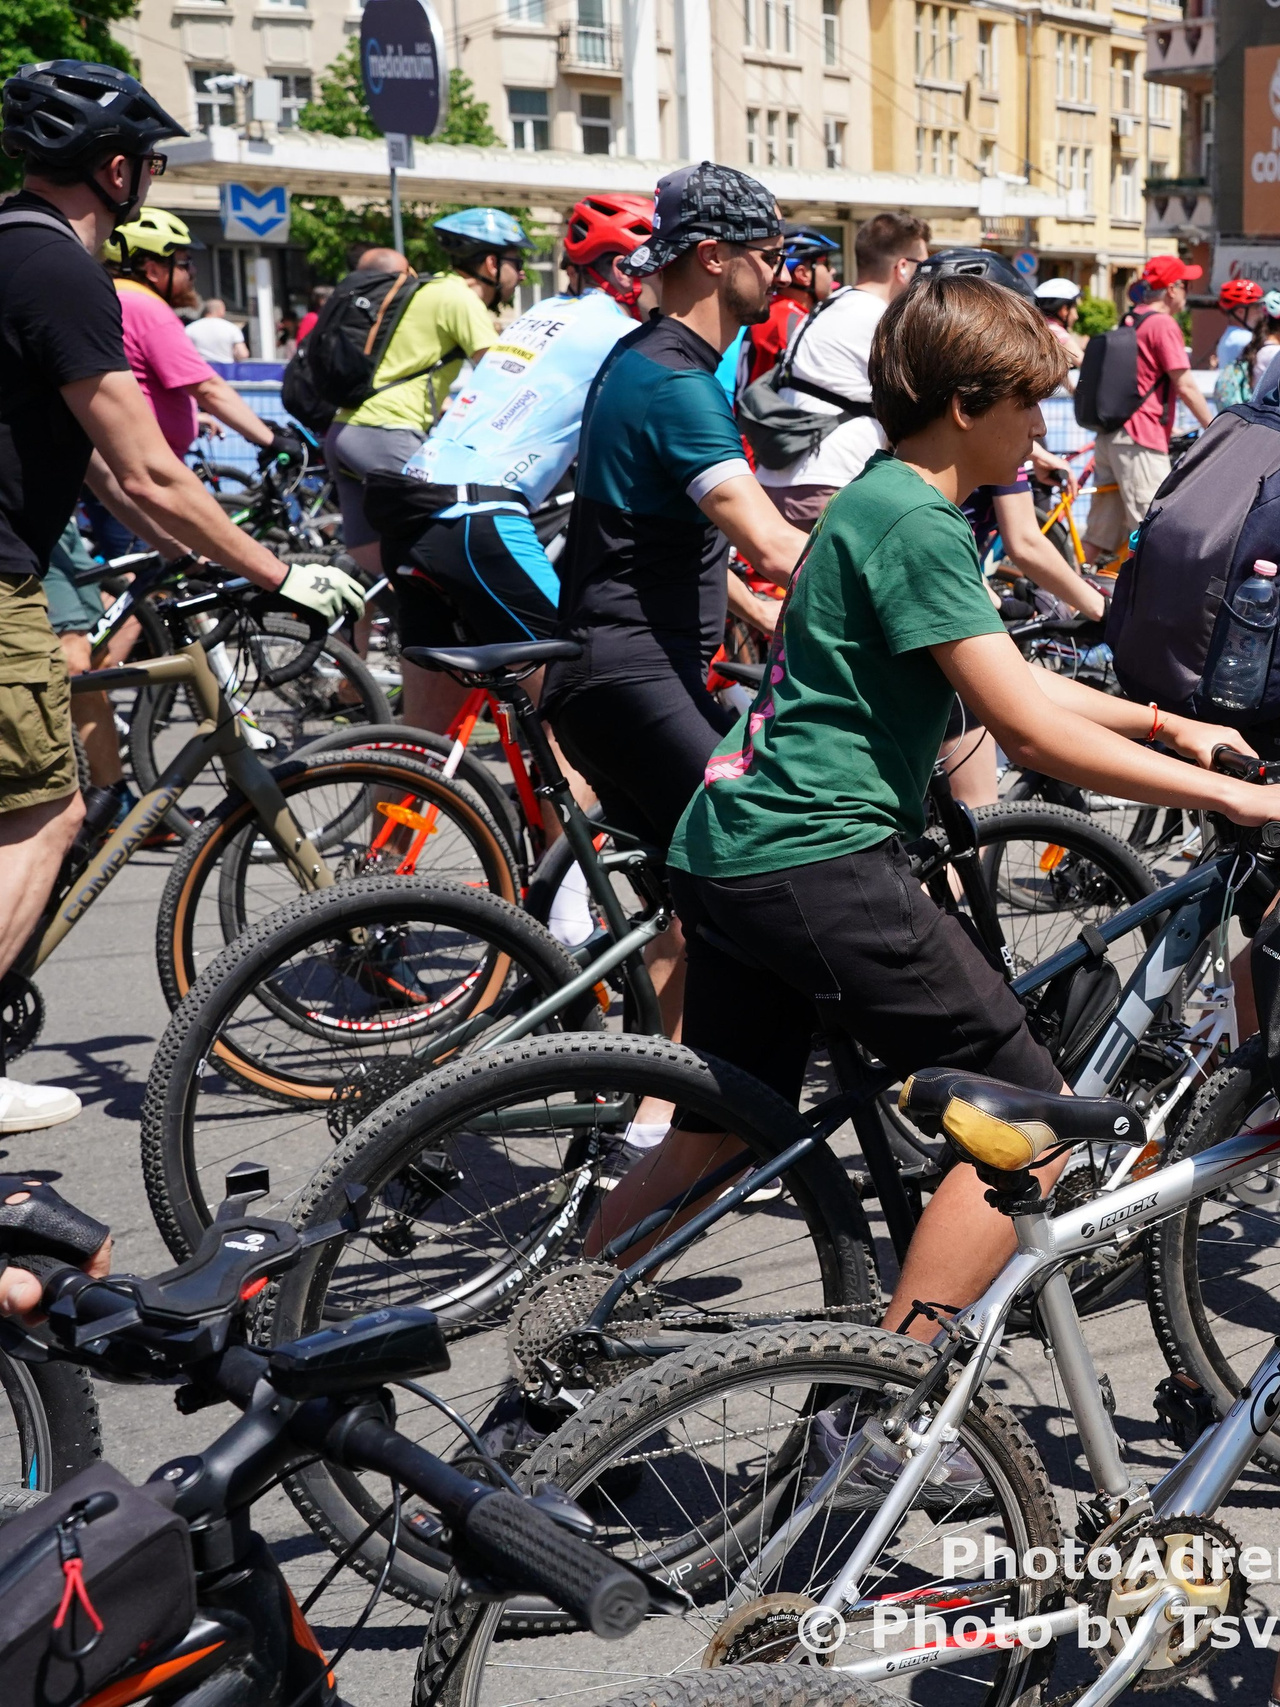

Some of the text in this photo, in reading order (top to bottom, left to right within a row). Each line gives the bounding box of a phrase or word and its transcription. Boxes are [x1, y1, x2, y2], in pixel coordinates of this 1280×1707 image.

[1100, 1192, 1159, 1231] ROCK
[766, 1612, 800, 1622] SHIMANO
[898, 1650, 940, 1670] ROCK
